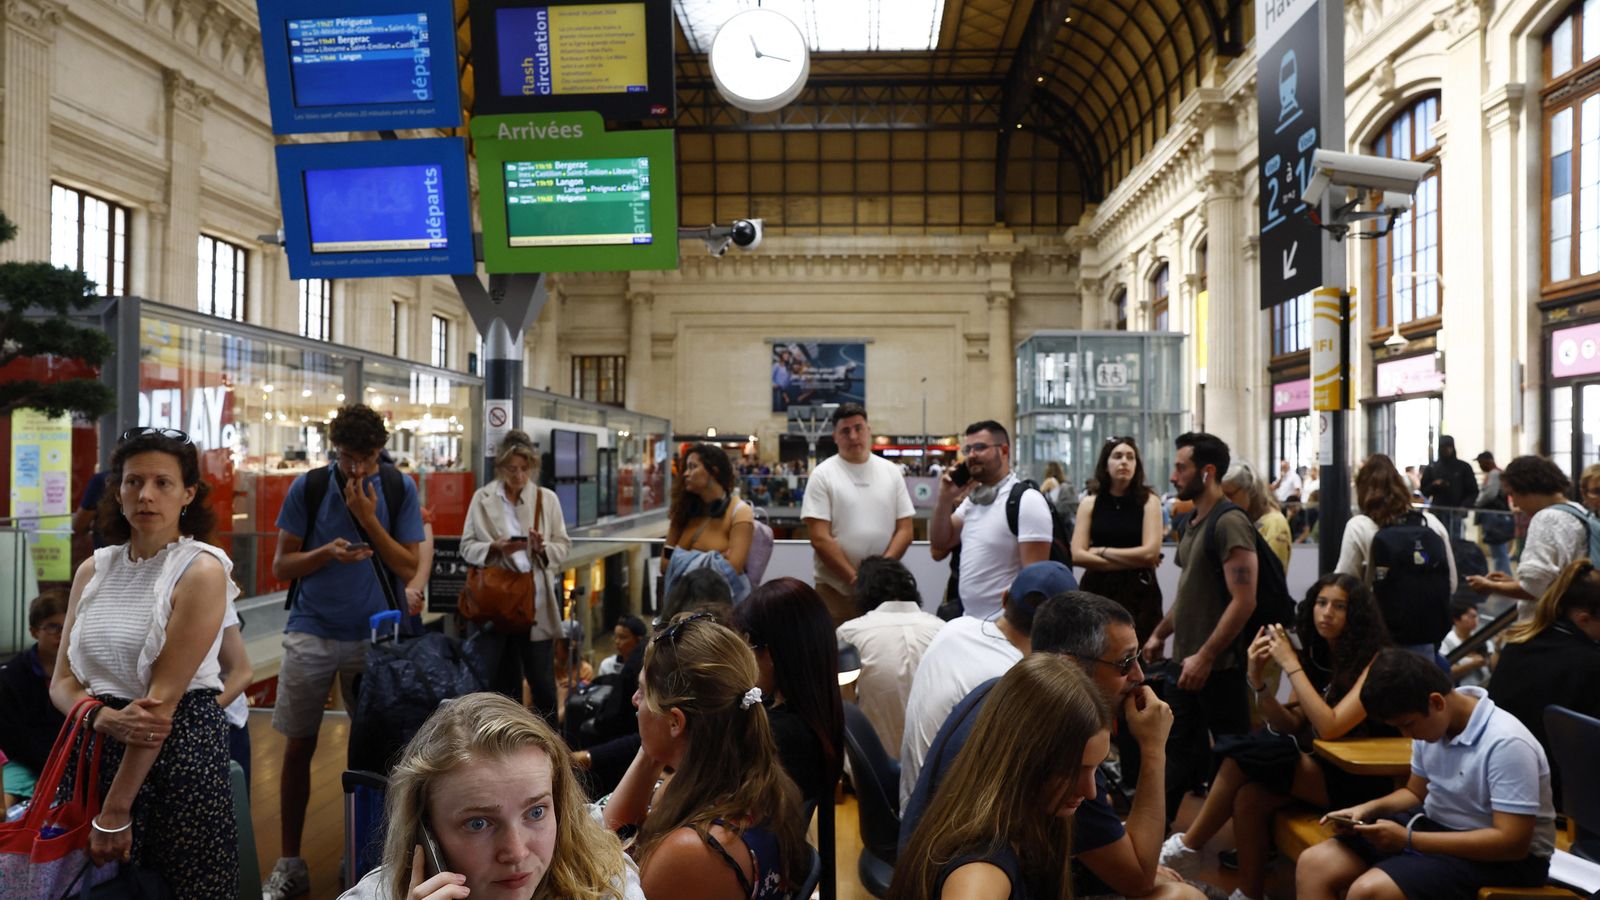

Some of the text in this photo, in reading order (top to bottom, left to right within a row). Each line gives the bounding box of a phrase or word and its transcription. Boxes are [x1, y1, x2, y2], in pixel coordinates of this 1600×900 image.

[336, 17, 373, 28] Périgueux
[337, 35, 370, 45] Bergerac
[319, 45, 347, 53] Libourne
[534, 10, 550, 95] circulation
[339, 53, 363, 63] Langon
[521, 57, 535, 95] flash
[497, 120, 584, 140] Arrivées
[554, 161, 588, 171] Bergerac
[555, 178, 584, 187] Langon
[563, 186, 587, 194] Langon
[1268, 177, 1279, 221] 2
[1286, 162, 1293, 183] à
[556, 193, 587, 203] Périgueux
[424, 167, 443, 240] départs
